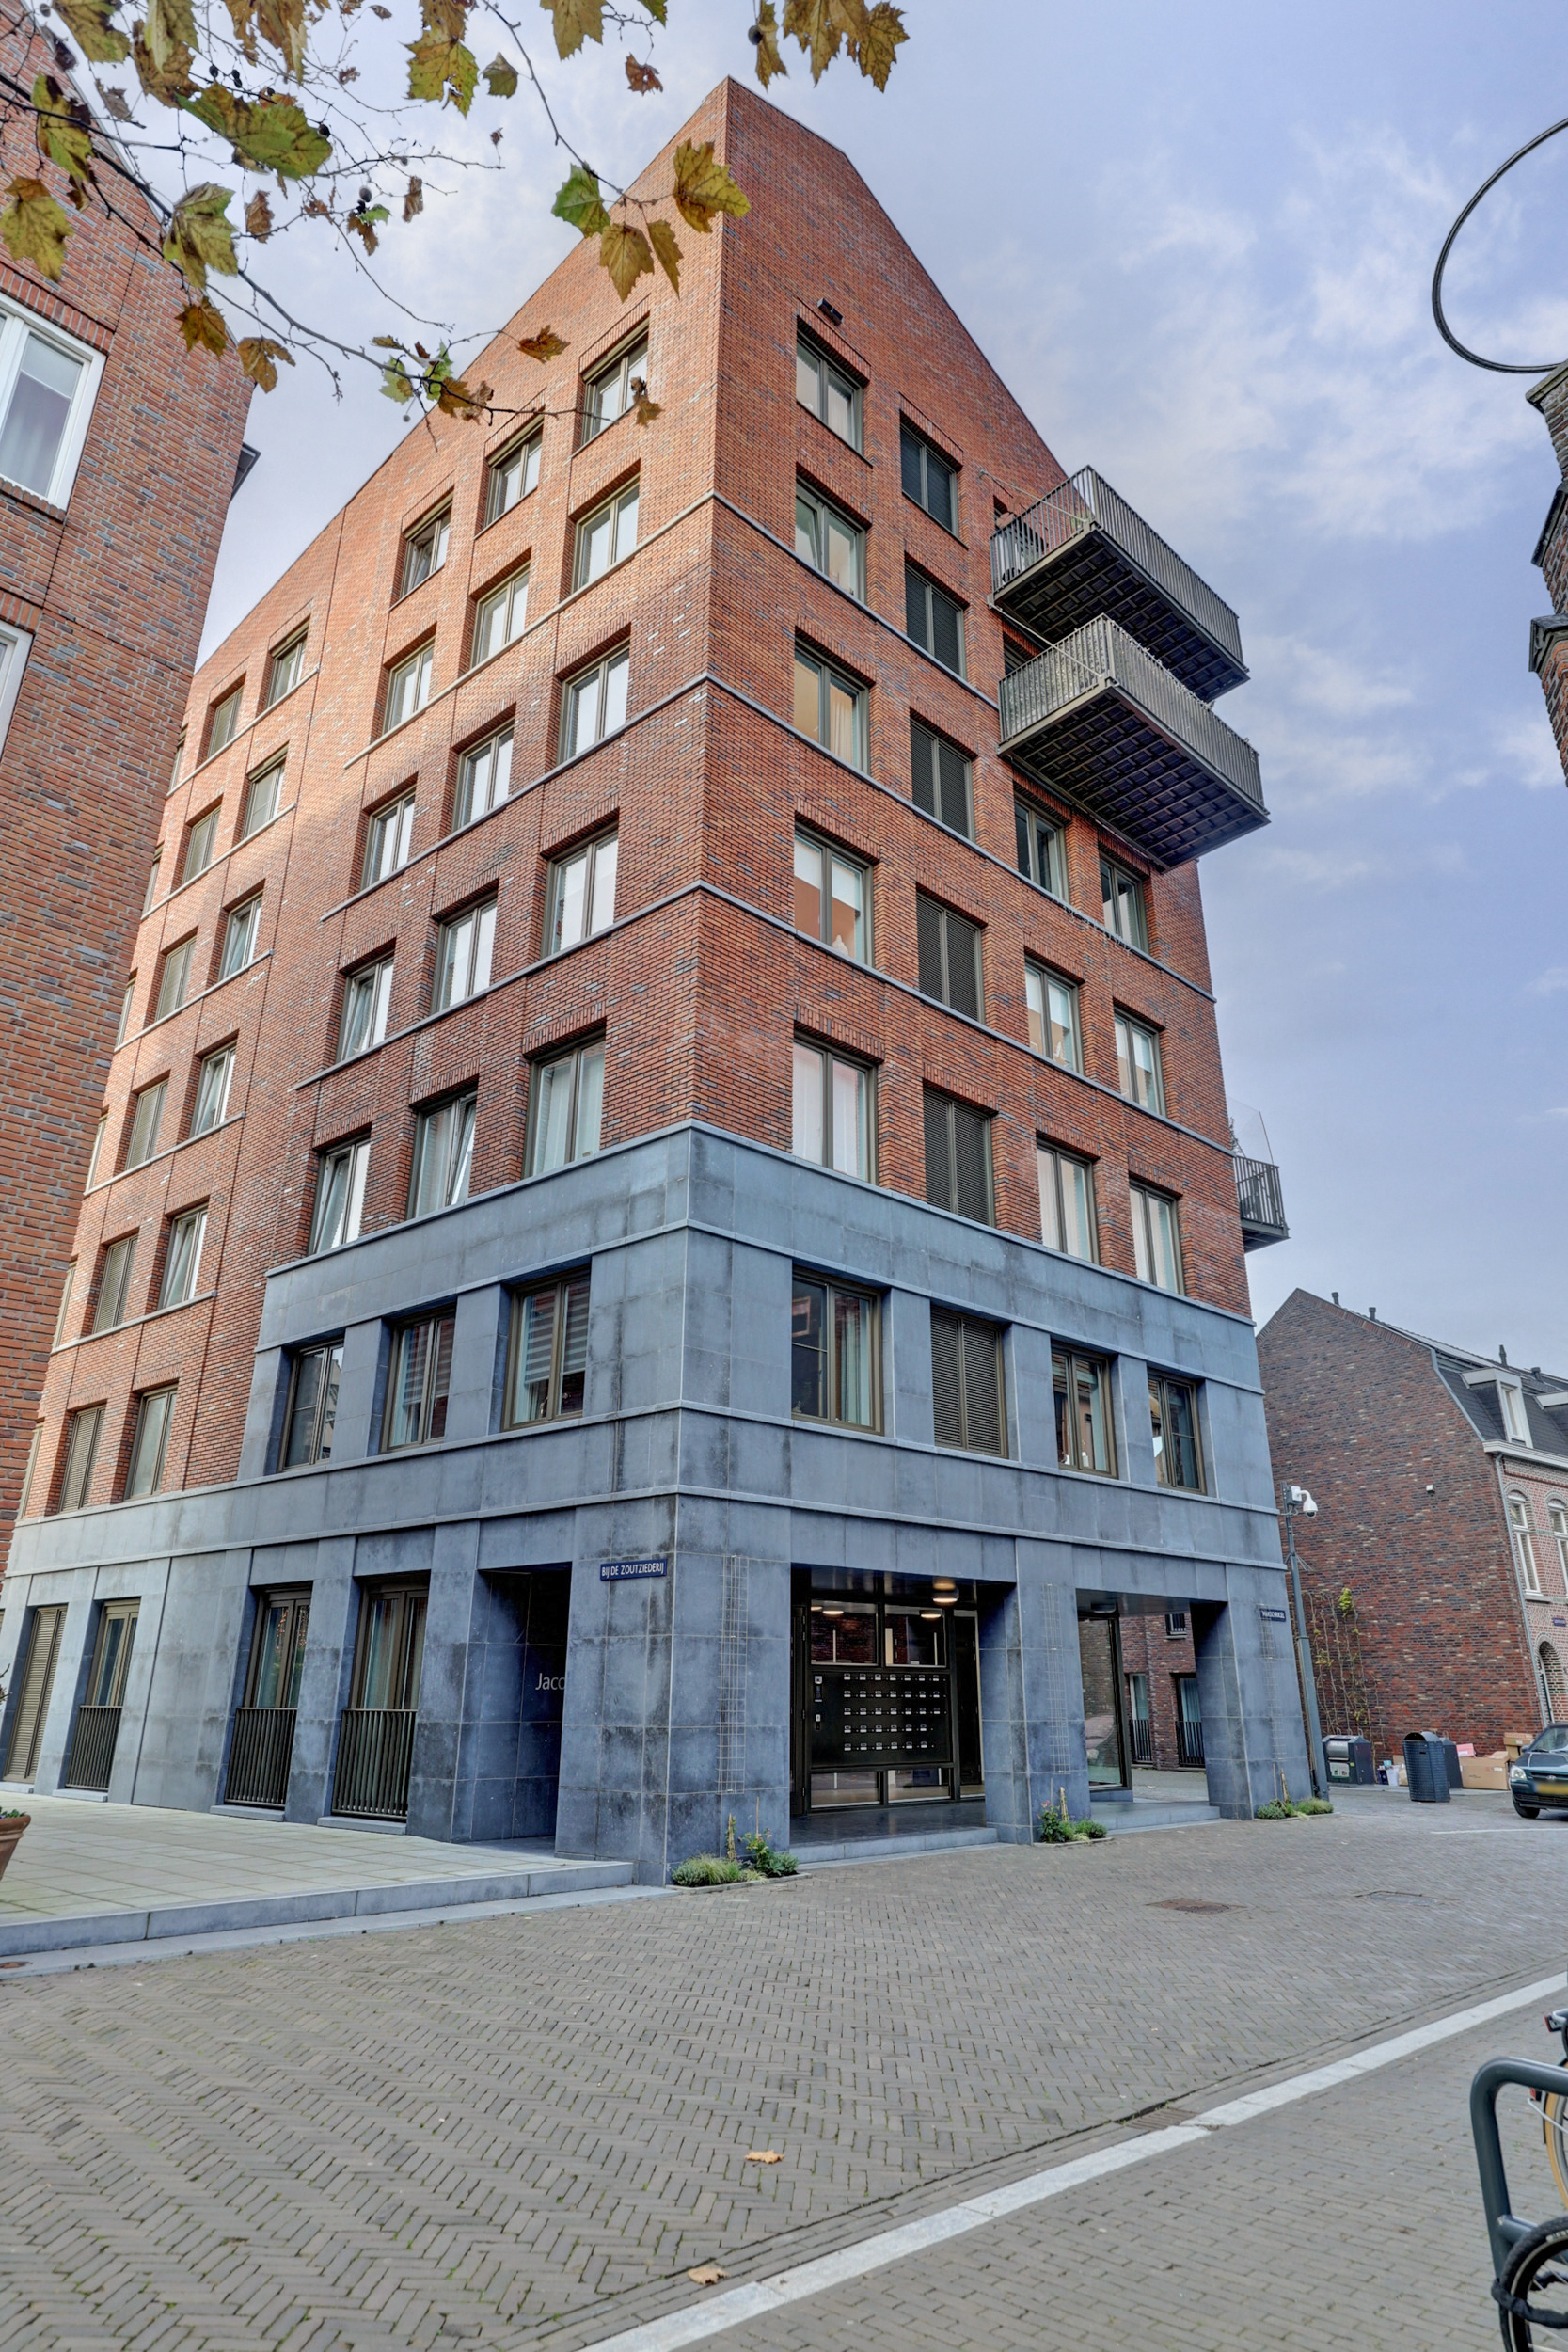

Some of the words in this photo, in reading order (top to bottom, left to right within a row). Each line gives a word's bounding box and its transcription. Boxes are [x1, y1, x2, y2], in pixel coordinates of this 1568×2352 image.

[601, 1566, 610, 1579] BIJ
[610, 1565, 619, 1576] DE
[621, 1562, 664, 1575] ZOUTZIEDERIJ
